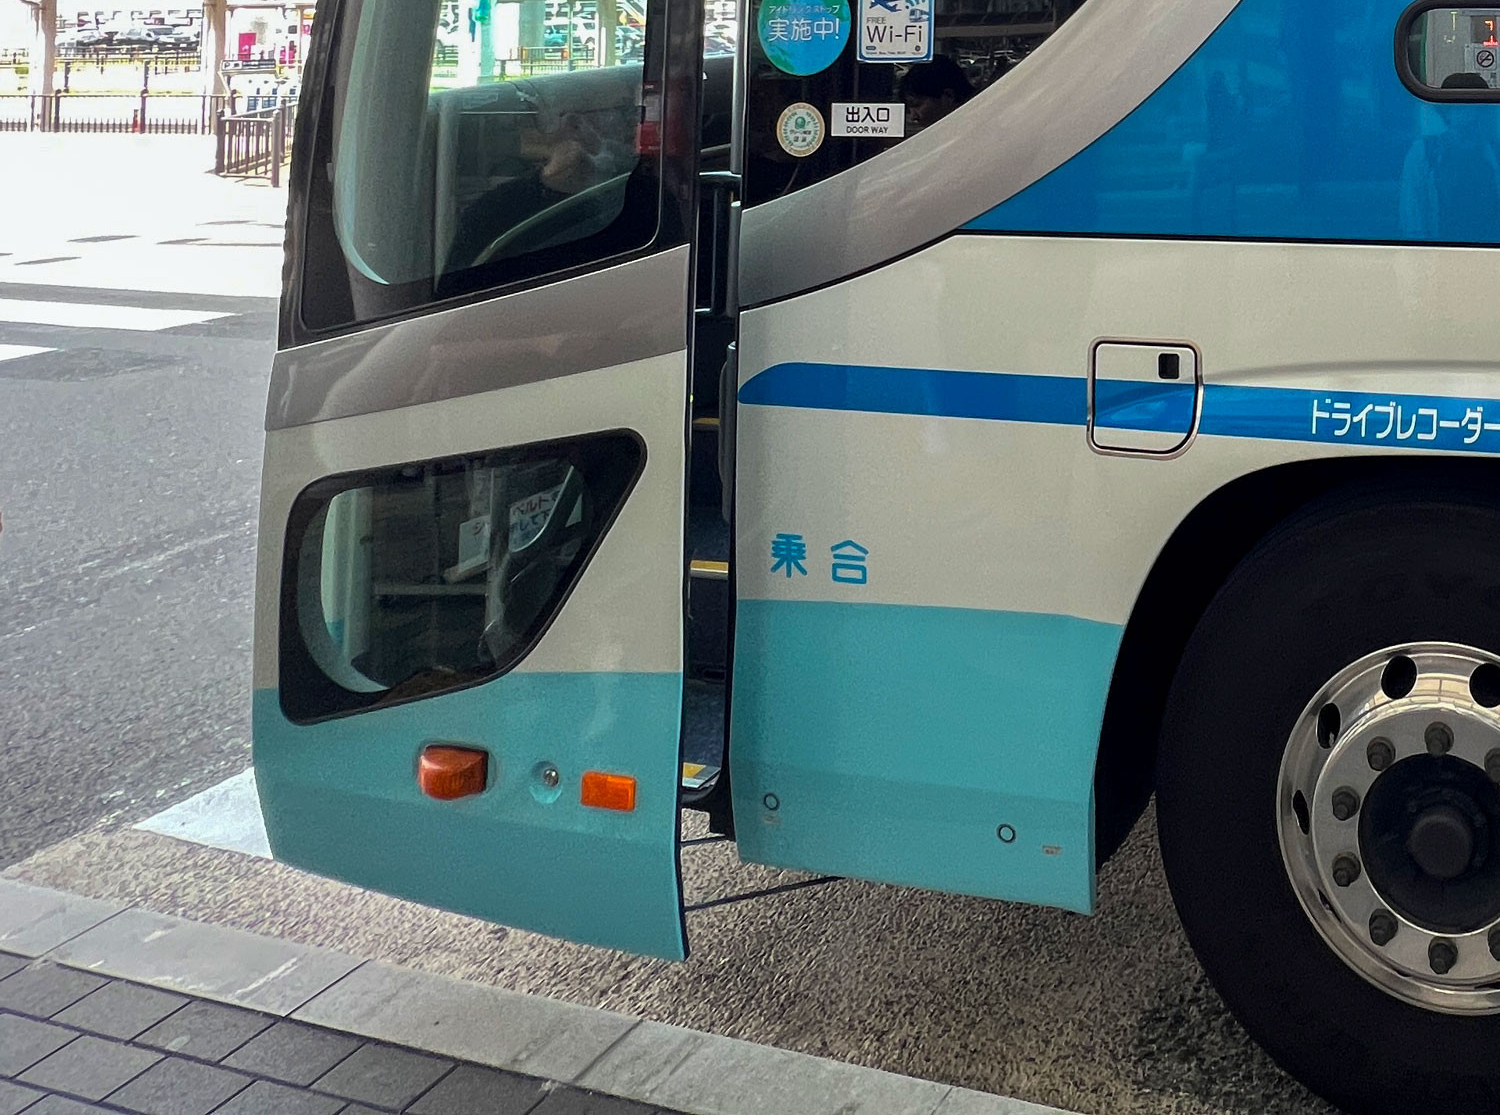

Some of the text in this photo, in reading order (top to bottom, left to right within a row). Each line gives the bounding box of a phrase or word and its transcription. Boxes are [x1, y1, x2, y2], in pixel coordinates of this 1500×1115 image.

[768, 17, 840, 42] 実施中!
[866, 16, 887, 25] FREE
[866, 25, 922, 43] Wi-Fi
[845, 106, 890, 124] 出入口
[846, 126, 889, 134] DOOR WAY
[770, 533, 869, 585] 乗合
